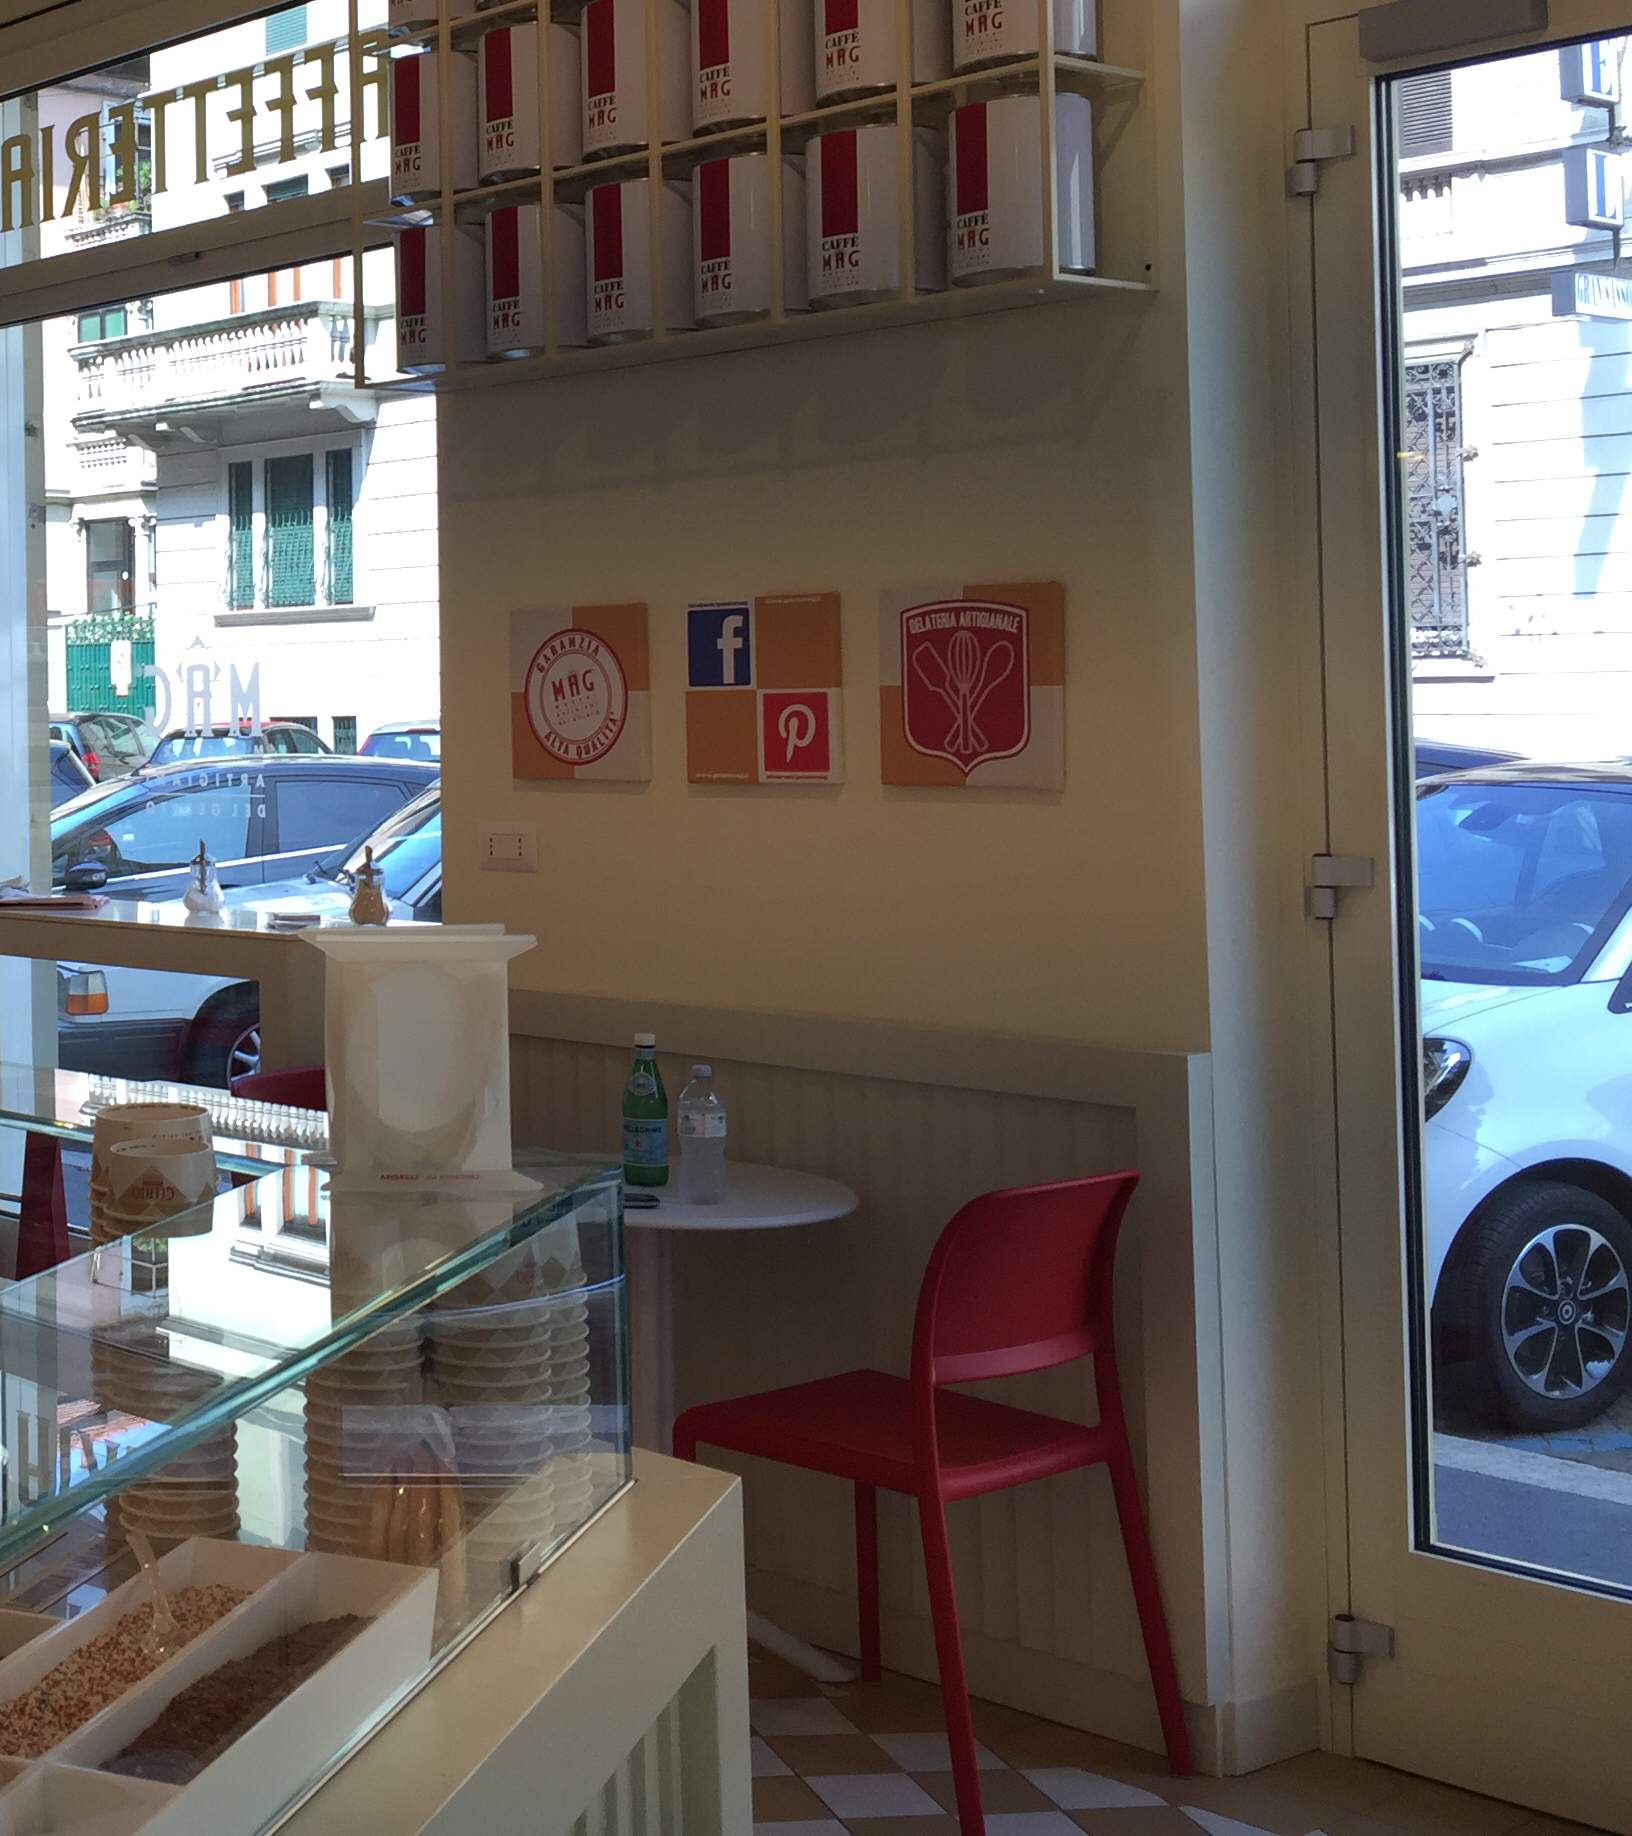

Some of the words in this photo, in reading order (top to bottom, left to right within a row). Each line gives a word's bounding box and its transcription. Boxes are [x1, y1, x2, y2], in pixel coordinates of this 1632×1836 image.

[965, 11, 1004, 37] MAG
[826, 45, 861, 69] MAG
[700, 80, 731, 102] MAG
[588, 108, 617, 129] MAG
[487, 133, 515, 153] MAG
[395, 157, 421, 175] MAG
[957, 227, 991, 250] MAG
[822, 250, 861, 272] MAG
[701, 272, 732, 293] MAG
[594, 292, 625, 312] MAG
[492, 311, 520, 330] MAG
[400, 328, 426, 346] MAG
[908, 612, 956, 635] GELATERIA
[959, 611, 1021, 634] ARTIGIANALE
[535, 635, 601, 674] GARANZIA
[551, 668, 596, 702] MAG
[543, 730, 570, 757] ALTA
